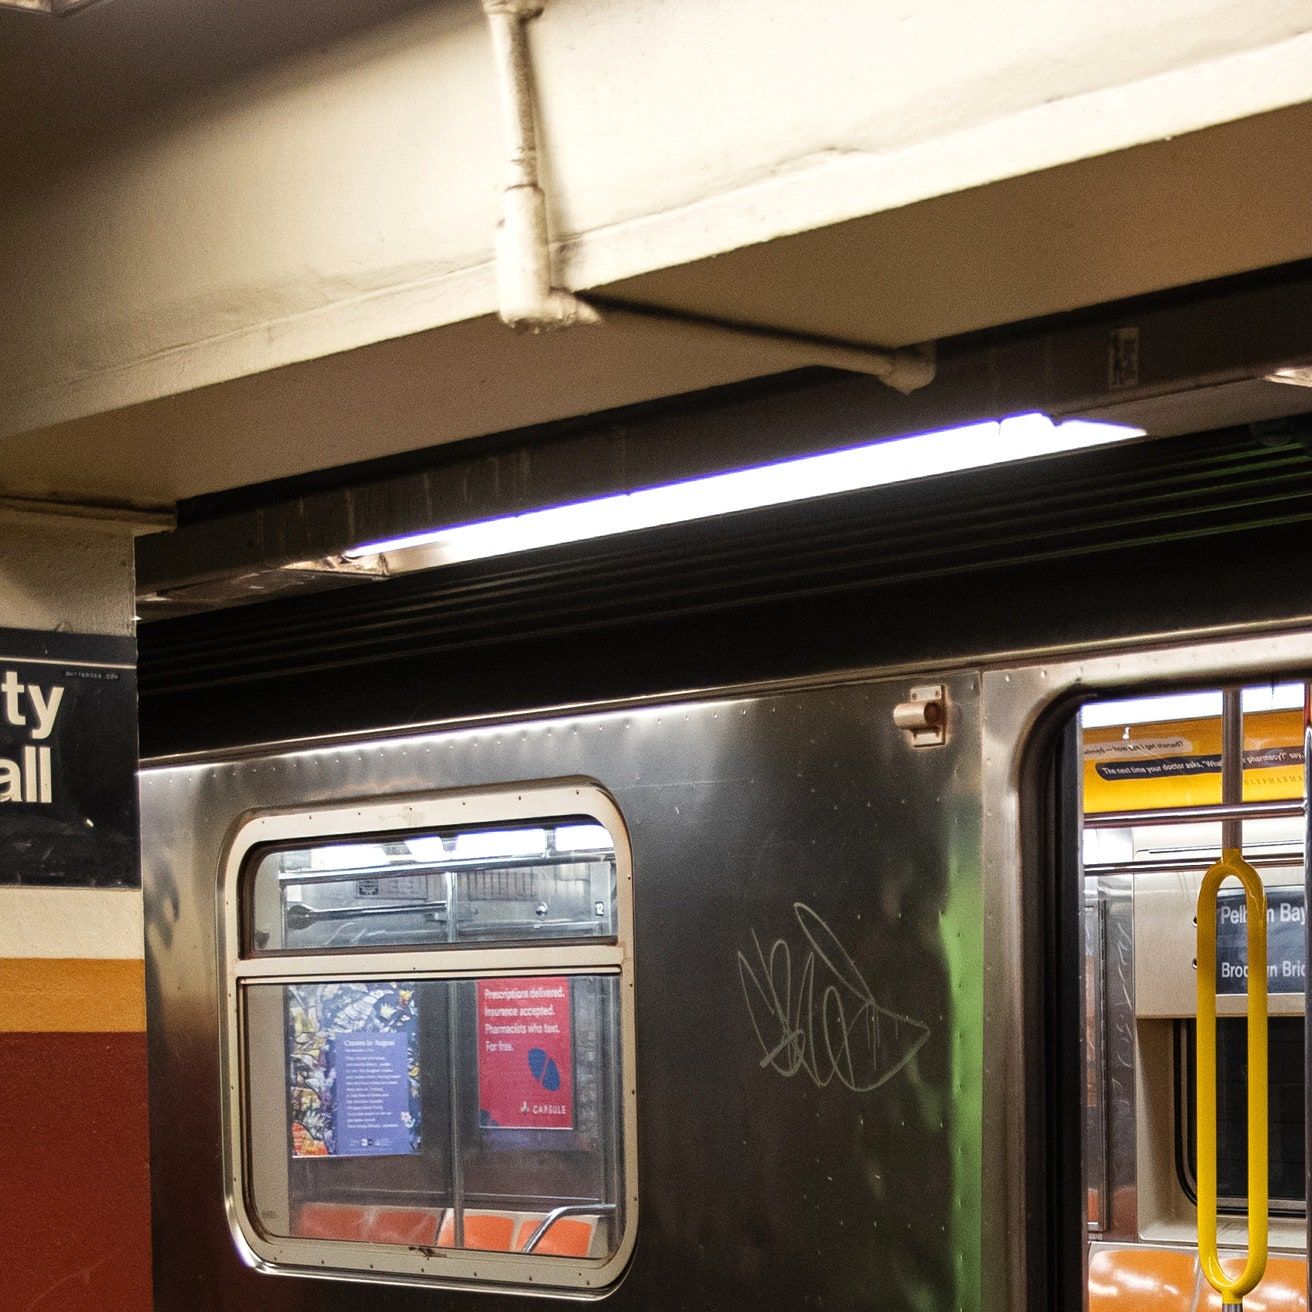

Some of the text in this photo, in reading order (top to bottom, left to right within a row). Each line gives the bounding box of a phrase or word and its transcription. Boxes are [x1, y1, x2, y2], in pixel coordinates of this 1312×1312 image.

[1, 671, 64, 739] ty
[0, 746, 52, 803] all
[1148, 766, 1161, 774] your
[1163, 763, 1185, 771] doctor
[1221, 904, 1274, 924] Pelhm
[532, 1105, 566, 1114] CAPSULE
